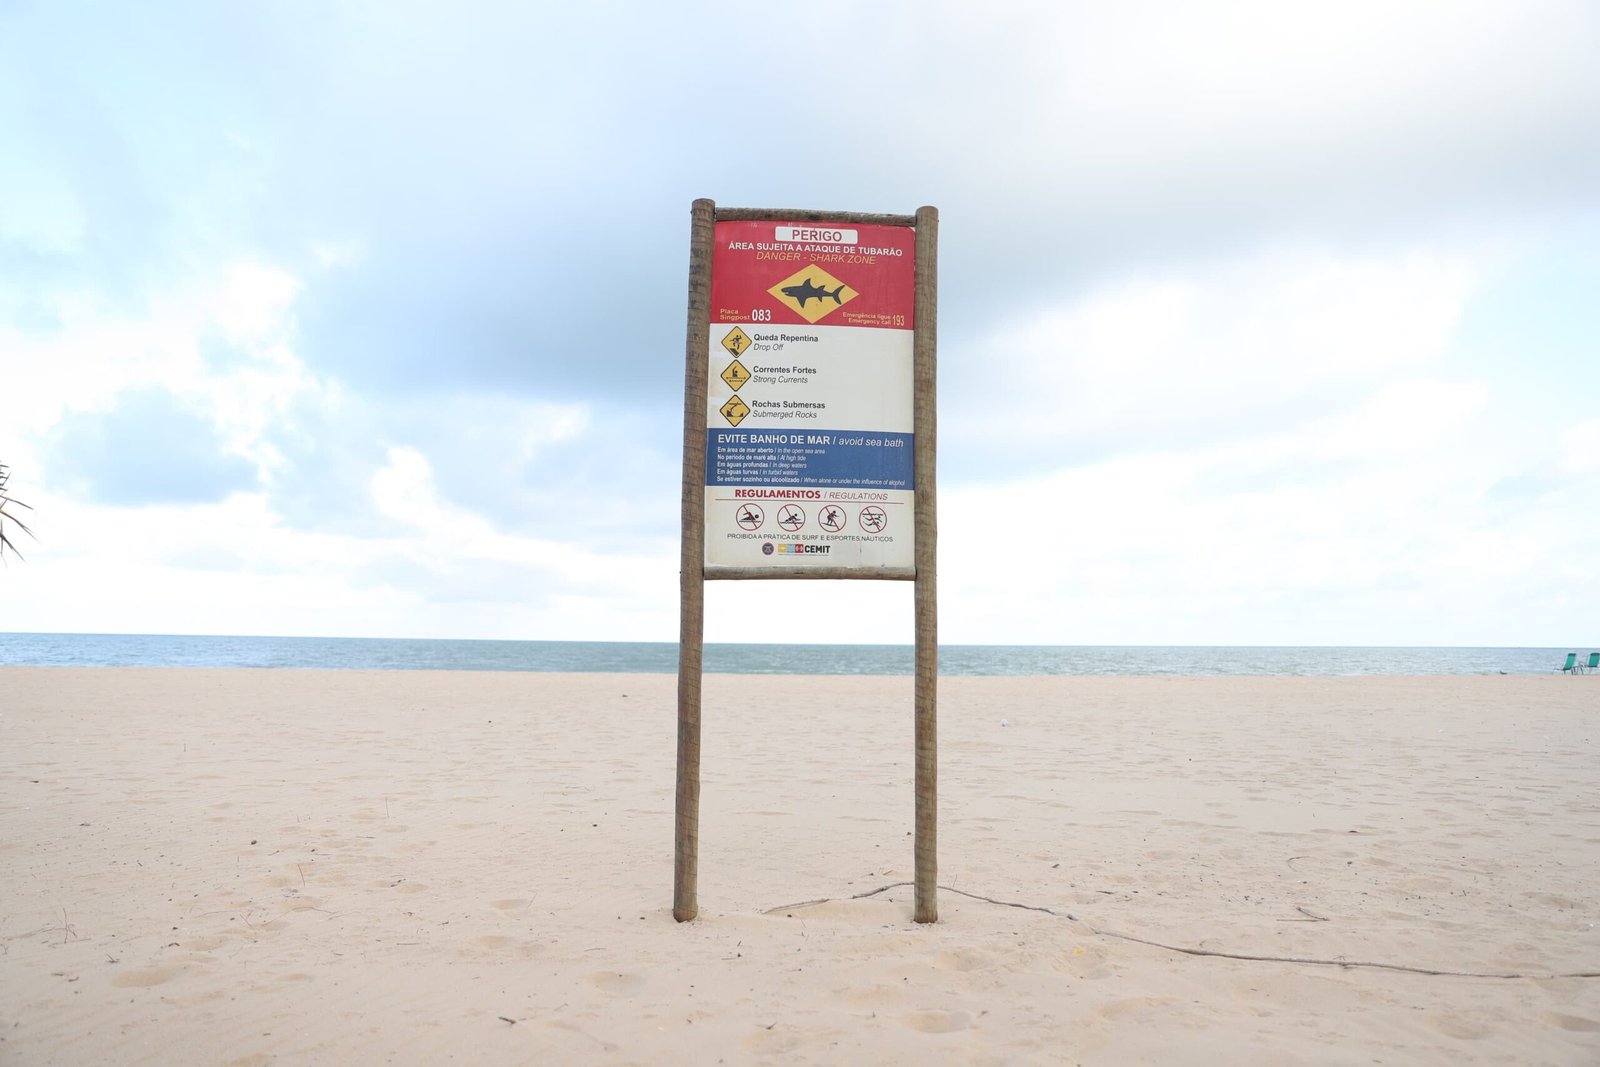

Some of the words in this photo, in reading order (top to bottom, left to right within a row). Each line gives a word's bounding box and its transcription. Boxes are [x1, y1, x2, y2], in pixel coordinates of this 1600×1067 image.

[792, 229, 842, 242] PERIGO
[728, 241, 754, 250] ÁREA
[757, 242, 794, 251] SUJEITA
[804, 244, 840, 253] ATAQUE
[858, 246, 902, 256] TUBARÃO
[756, 251, 800, 260] DANGER
[810, 254, 845, 263] SHARK
[848, 255, 876, 264] ZONE
[752, 309, 771, 321] 083
[892, 314, 905, 326] 193
[780, 334, 818, 342] Repentina
[753, 343, 771, 351] Drop
[753, 376, 776, 384] Strong
[753, 410, 793, 419] Submerged
[718, 434, 747, 443] EVITE
[750, 435, 787, 444] BANHO
[791, 436, 804, 444] DE
[807, 436, 830, 445] MAR
[839, 437, 863, 446] avoid
[884, 438, 904, 447] bath
[735, 489, 821, 499] REGULAMENTOS
[829, 492, 888, 500] REGULATIONS
[804, 545, 830, 553] CEMIT
